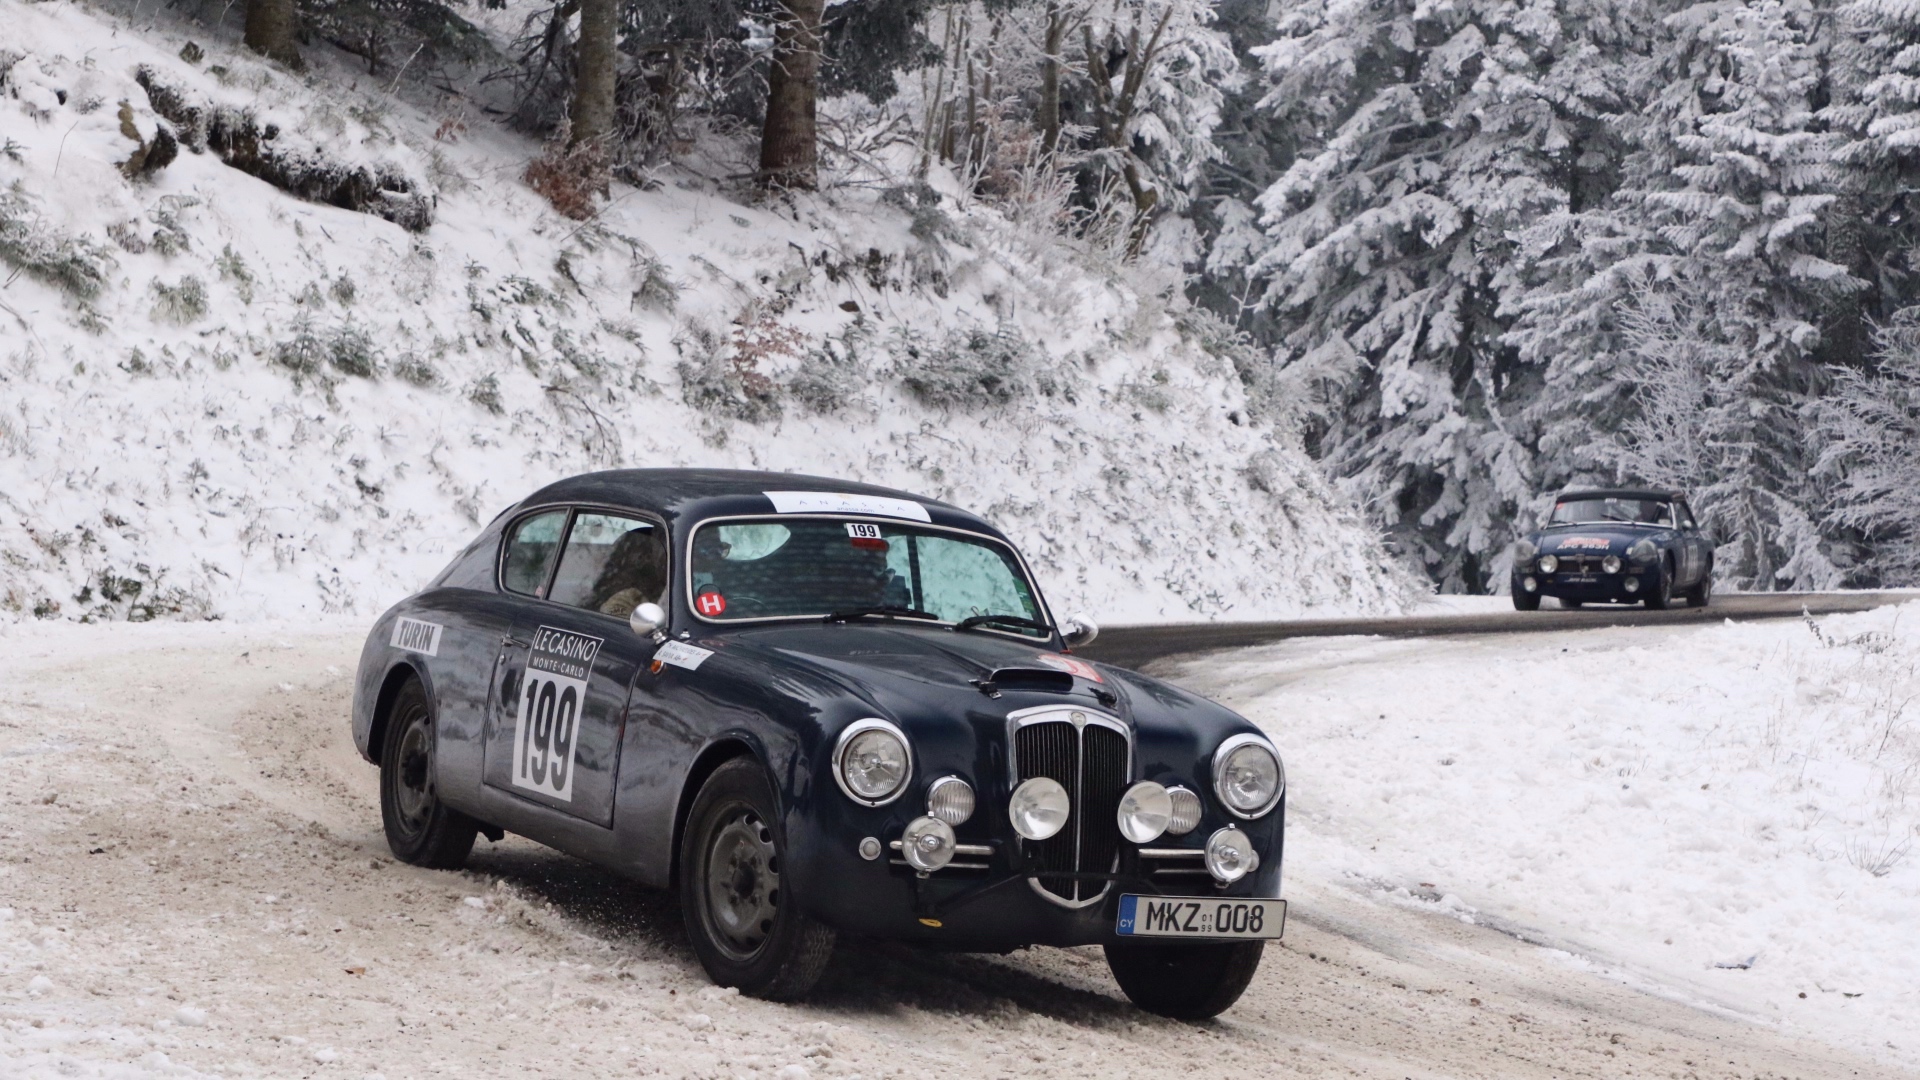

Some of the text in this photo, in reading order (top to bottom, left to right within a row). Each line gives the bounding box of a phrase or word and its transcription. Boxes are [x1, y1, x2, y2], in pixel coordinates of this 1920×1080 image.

[799, 500, 905, 512] ANASSA
[851, 524, 877, 537] 199
[701, 594, 722, 613] H
[398, 620, 436, 652] TURIN
[521, 678, 577, 792] 199
[1119, 918, 1134, 928] CY
[1145, 901, 1265, 934] MKZ 008
